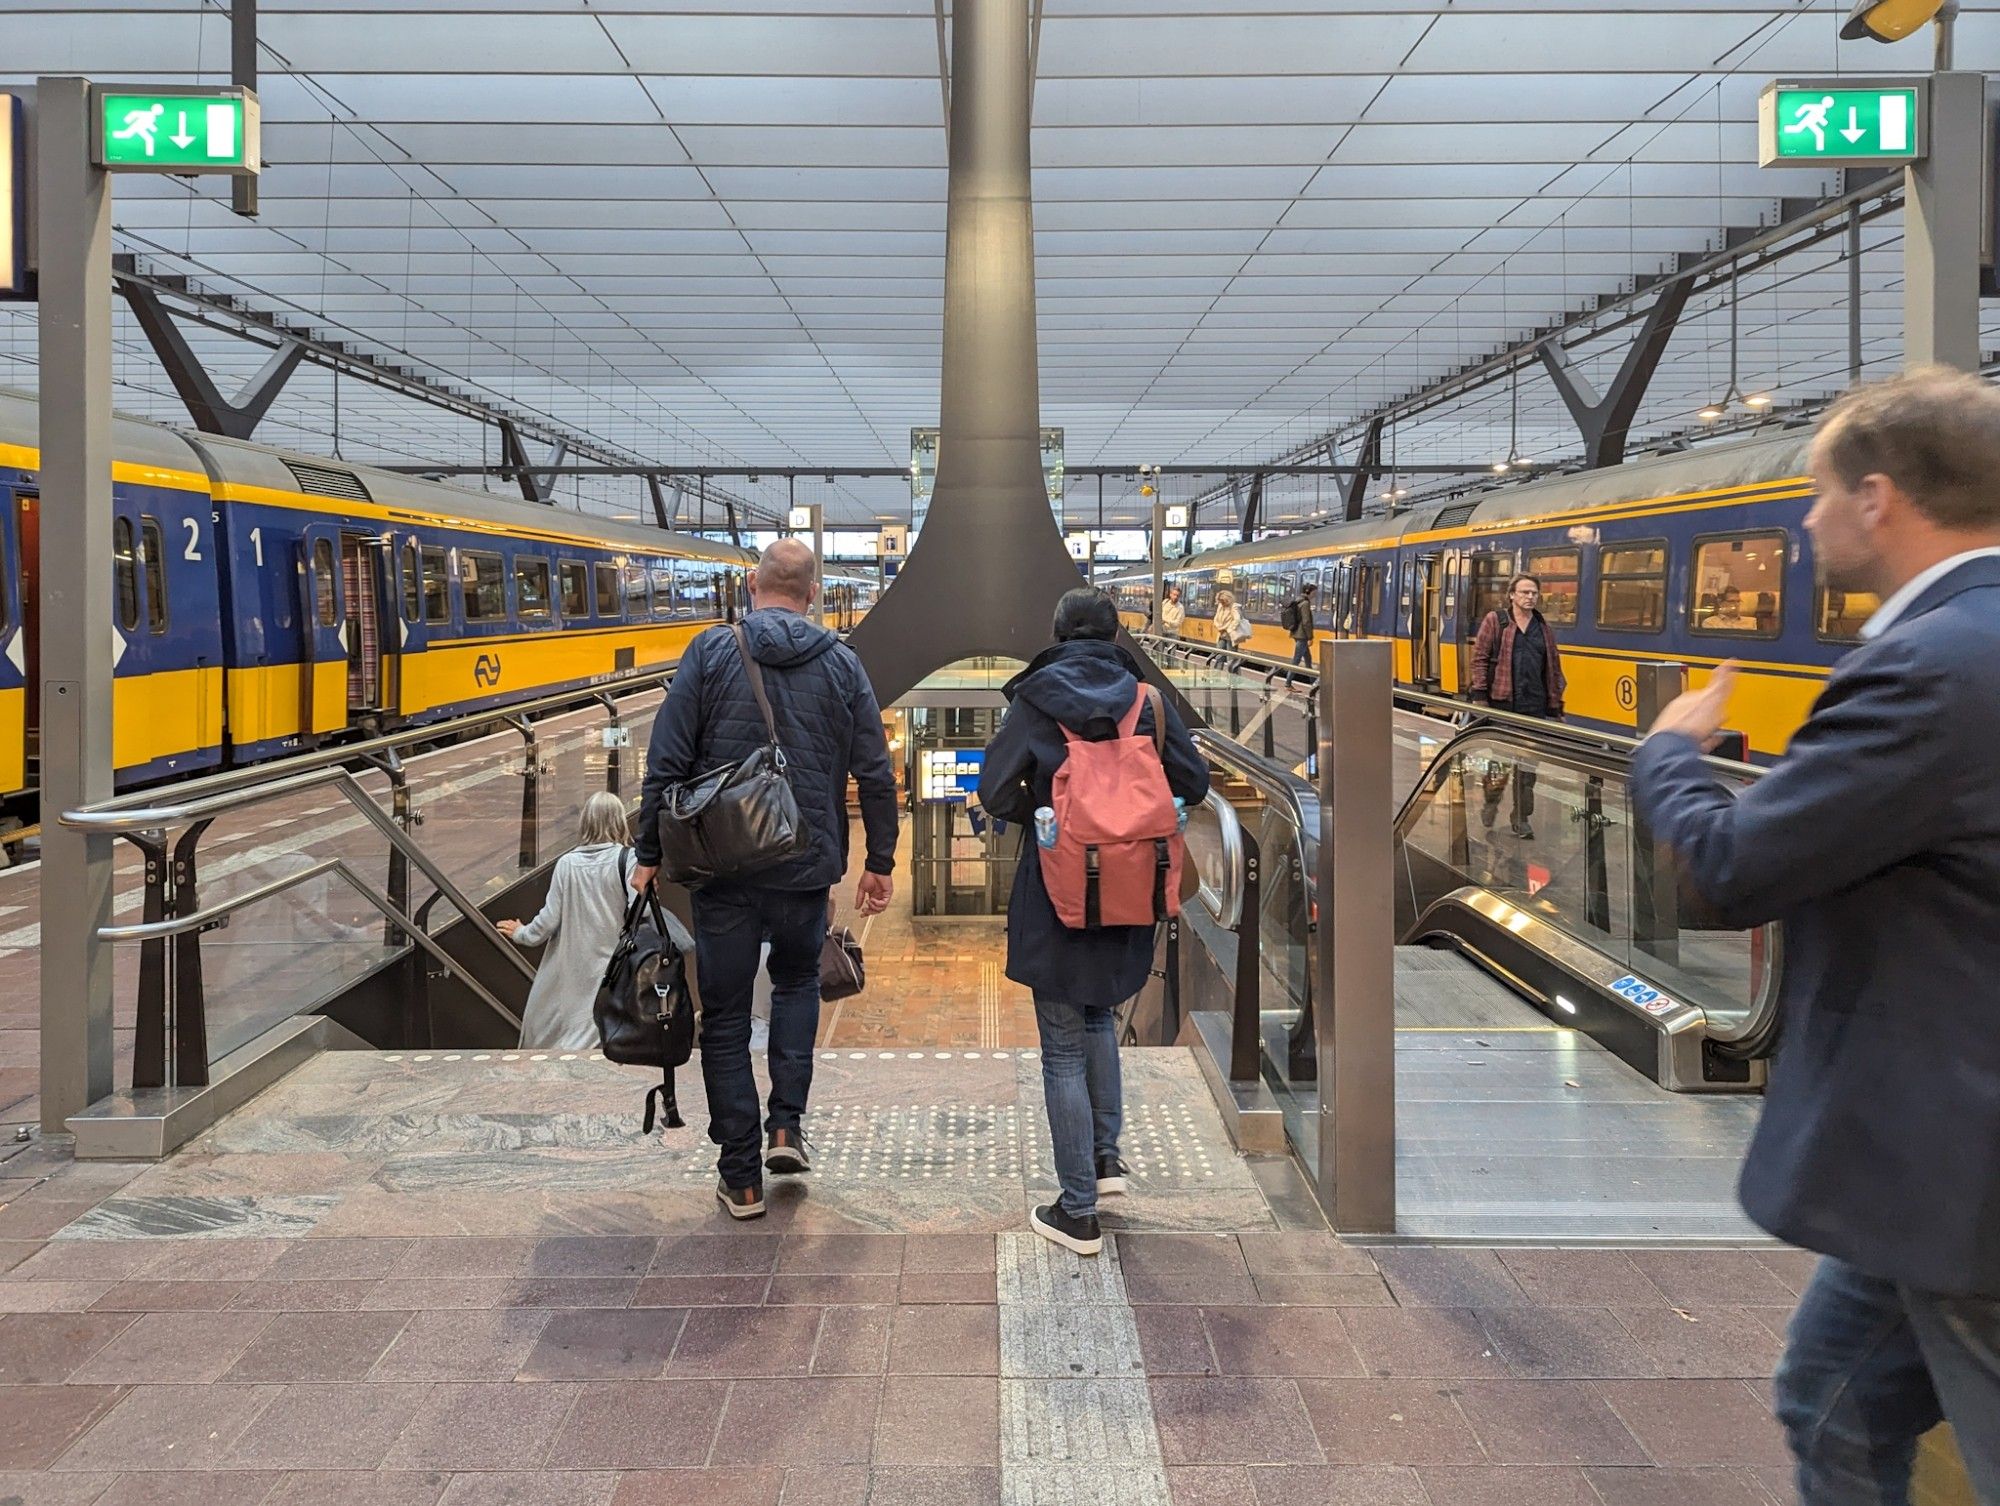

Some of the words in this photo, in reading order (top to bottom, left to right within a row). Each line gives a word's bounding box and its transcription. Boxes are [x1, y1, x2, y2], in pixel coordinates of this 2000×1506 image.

[795, 515, 805, 526] D
[1172, 514, 1181, 525] D
[182, 517, 202, 561] 2
[249, 527, 263, 567] 1
[450, 546, 458, 576] 1
[1385, 560, 1392, 584] 2
[1621, 679, 1633, 705] B
